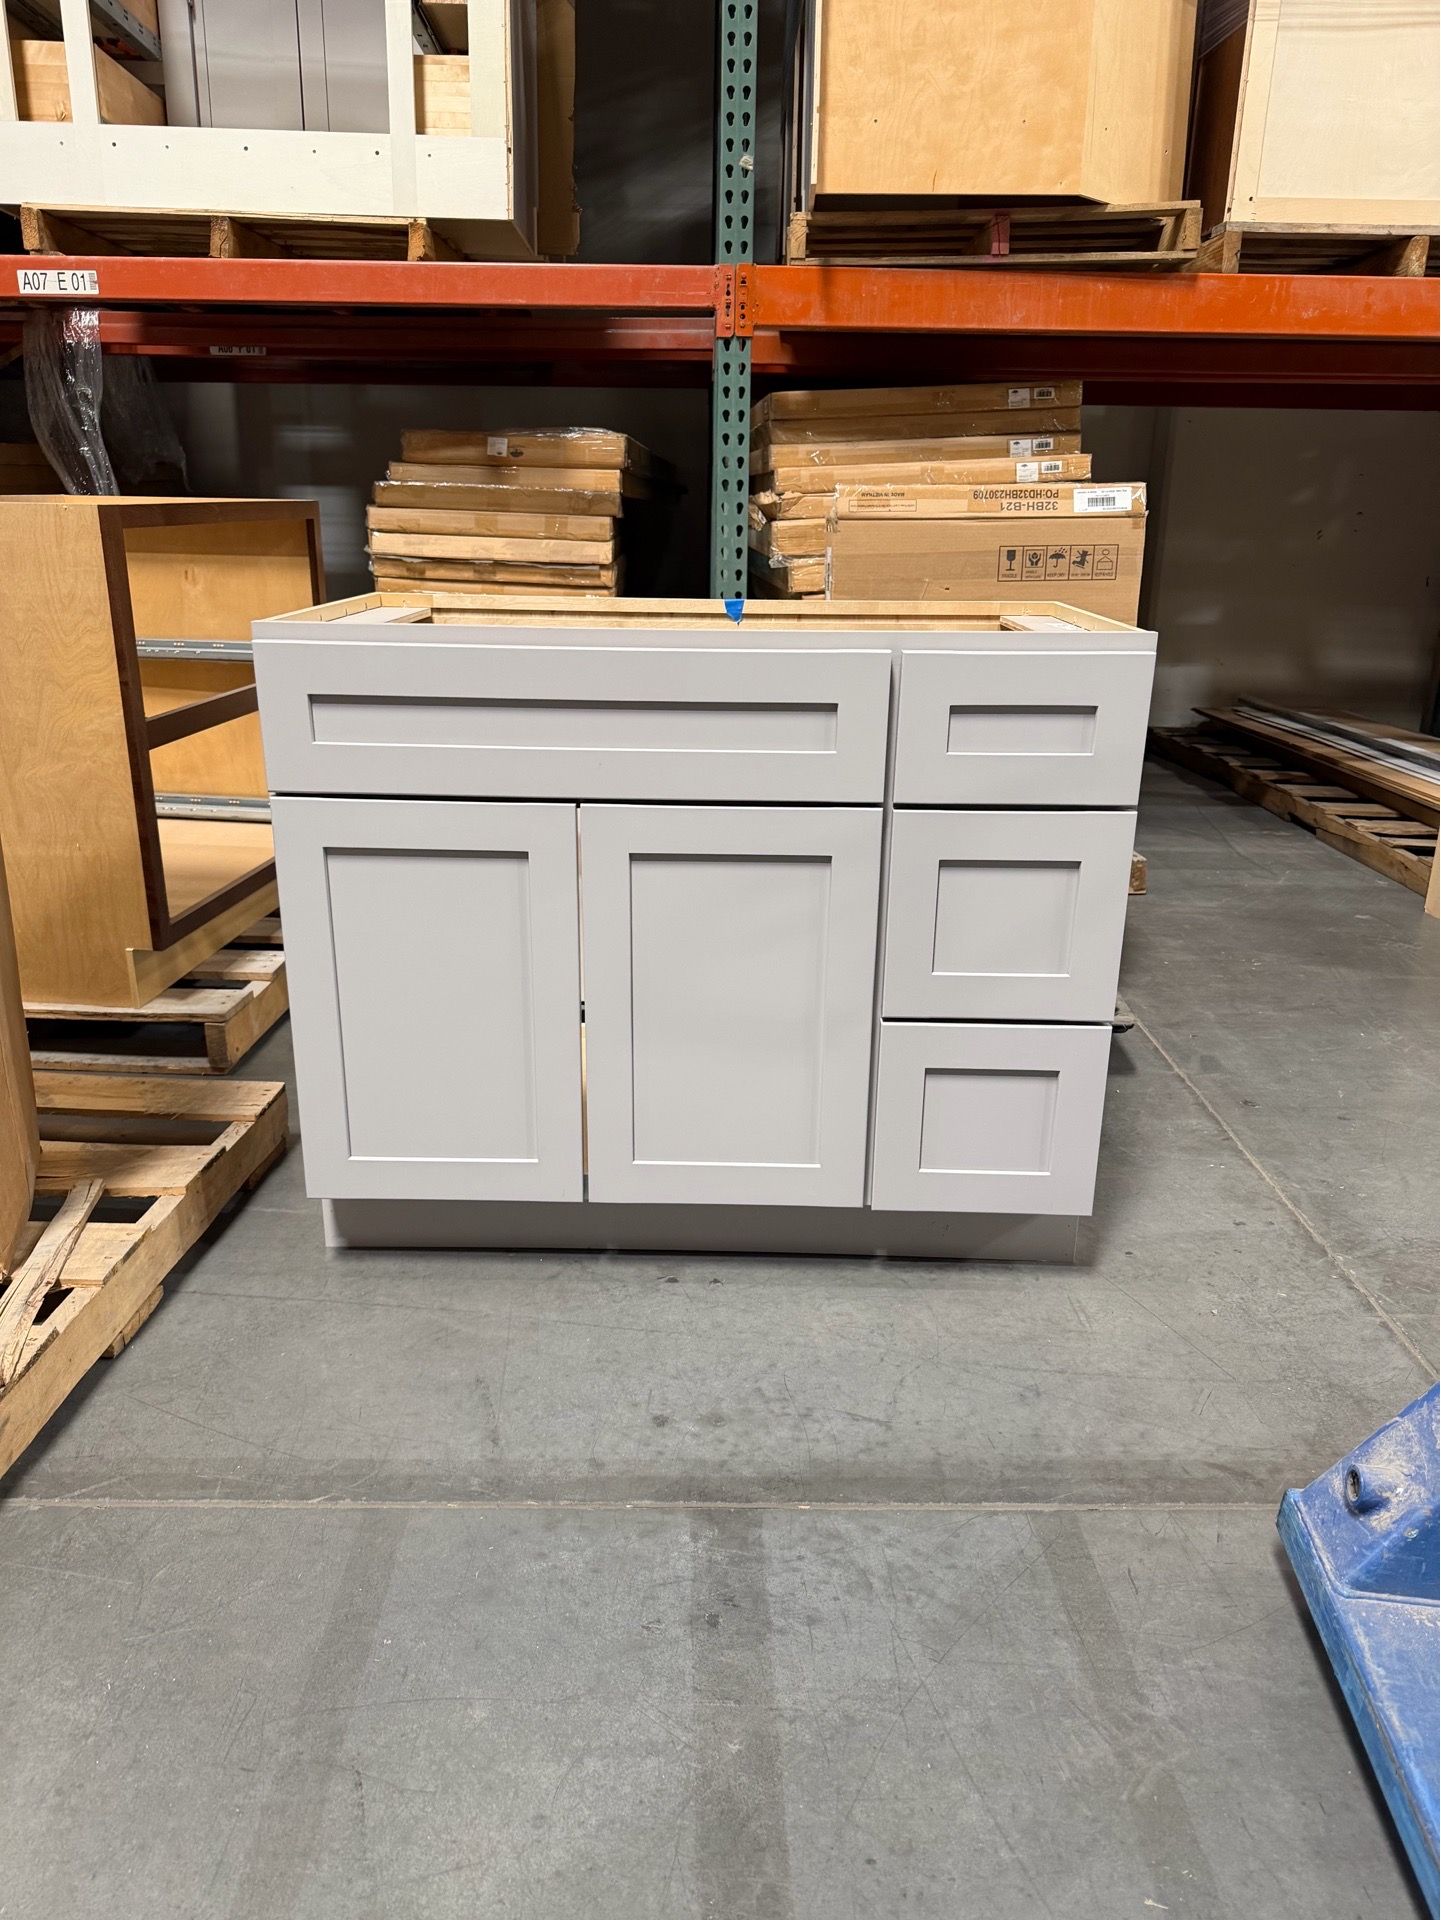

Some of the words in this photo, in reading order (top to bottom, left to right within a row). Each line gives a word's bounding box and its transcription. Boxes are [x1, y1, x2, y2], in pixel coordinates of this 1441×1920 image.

[22, 272, 48, 291] A07
[57, 271, 68, 291] E
[71, 273, 87, 291] 01
[972, 489, 1059, 500] PO:HD32BH230709
[1000, 501, 1059, 512] 32BH-B21
